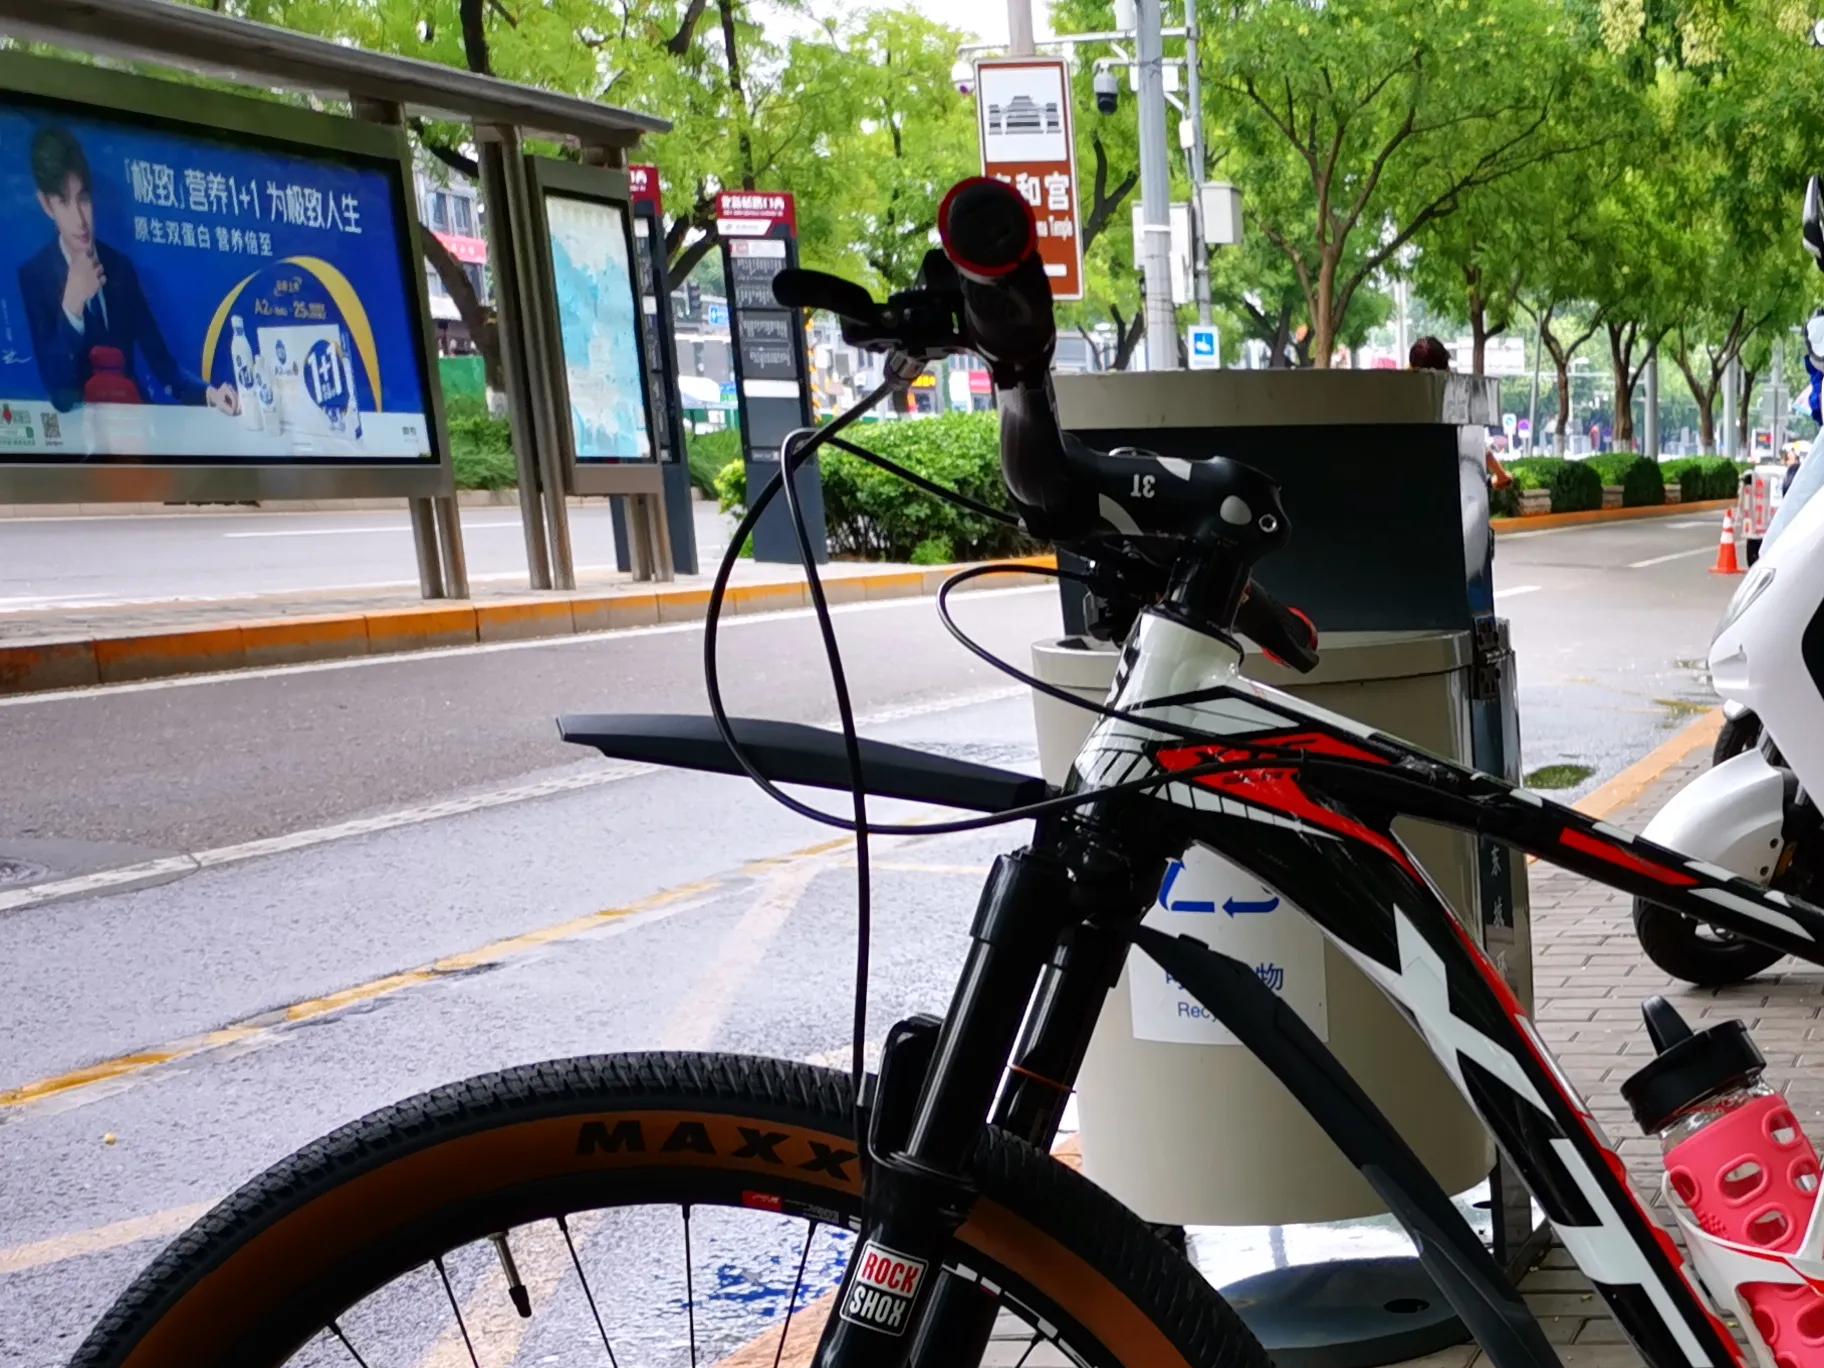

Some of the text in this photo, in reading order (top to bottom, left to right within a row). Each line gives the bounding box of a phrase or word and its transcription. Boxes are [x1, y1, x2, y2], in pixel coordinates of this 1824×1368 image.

[994, 170, 1070, 211] 和宫
[575, 1119, 859, 1183] MAXX
[860, 1250, 918, 1291] ROCK
[848, 1284, 907, 1328] SHOX
